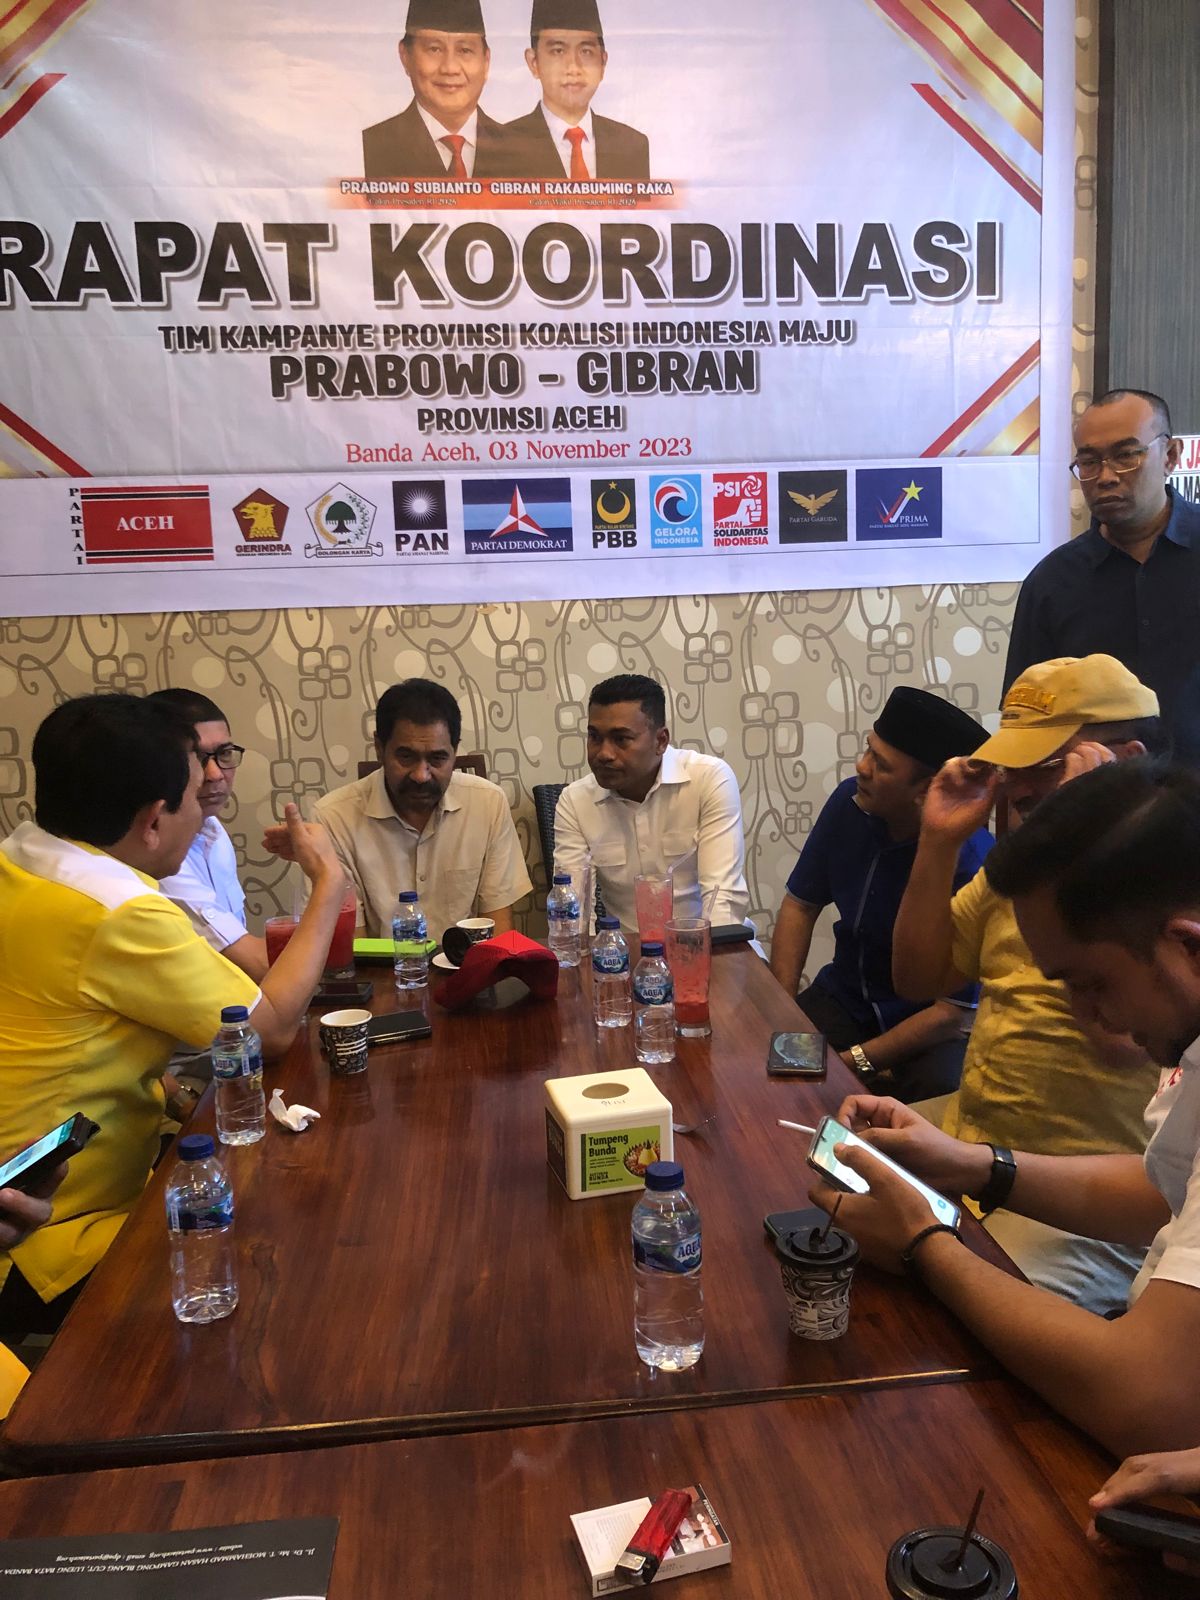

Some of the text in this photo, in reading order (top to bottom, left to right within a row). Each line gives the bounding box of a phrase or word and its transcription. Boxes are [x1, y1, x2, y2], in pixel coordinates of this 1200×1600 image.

[340, 181, 482, 194] PRABOWO SUBIANTO
[490, 182, 674, 195] GIBRAN RAKABUMING RAKA
[0, 220, 1004, 305] RAPAT KOORDINASI
[158, 319, 852, 350] TIM KAMPANYE PROVINSI KOALISI INDONESIA MAJU
[269, 353, 521, 398] PRABOWO
[576, 350, 756, 394] GIBRAN
[417, 405, 622, 431] PROVINSI ACEH
[346, 438, 692, 463] Banda Aceh, 03 November 2023
[713, 481, 740, 498] PSI
[116, 515, 175, 531] ACEH
[714, 521, 743, 529] PARTAI
[899, 515, 928, 523] PRIMA
[654, 527, 699, 537] GELORA
[713, 527, 769, 537] SOLIDARITAS
[395, 532, 449, 552] PAN
[471, 539, 568, 551] PARTAI DEMOKRAT
[592, 530, 638, 549] PBB
[654, 537, 699, 545] INDONESIA
[713, 536, 769, 547] INDONESIA
[235, 544, 292, 553] GERINDRA
[603, 958, 622, 966] AQUA
[643, 988, 663, 997] AQUA
[589, 1134, 629, 1148] Tumpeng
[589, 1147, 617, 1157] Bunda
[678, 1238, 700, 1258] AQU
